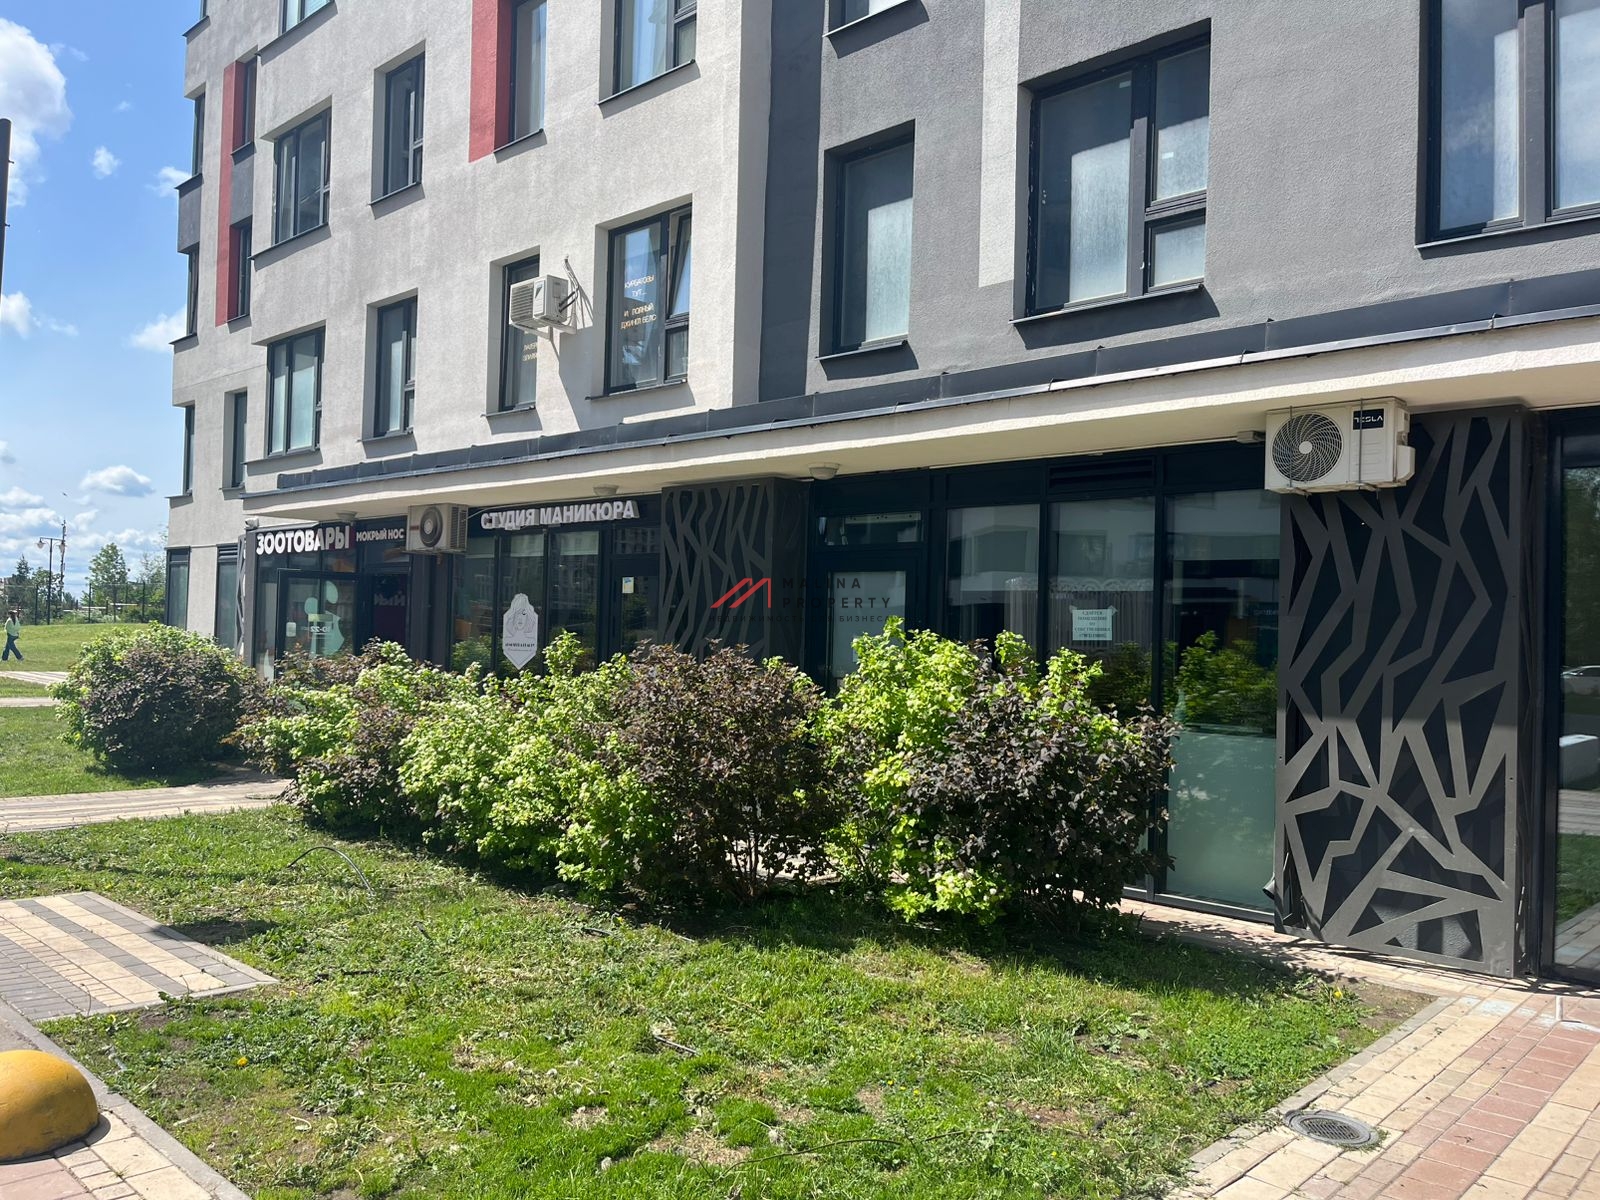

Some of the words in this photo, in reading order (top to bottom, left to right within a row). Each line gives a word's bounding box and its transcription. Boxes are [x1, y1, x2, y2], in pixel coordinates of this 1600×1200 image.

[480, 509, 539, 531] СТУДИЯ
[539, 500, 638, 525] МАНИКЮРА
[255, 526, 350, 555] ЗООТОВАРЫ
[356, 529, 387, 542] МОКРЫЙ
[388, 528, 405, 540] НОС
